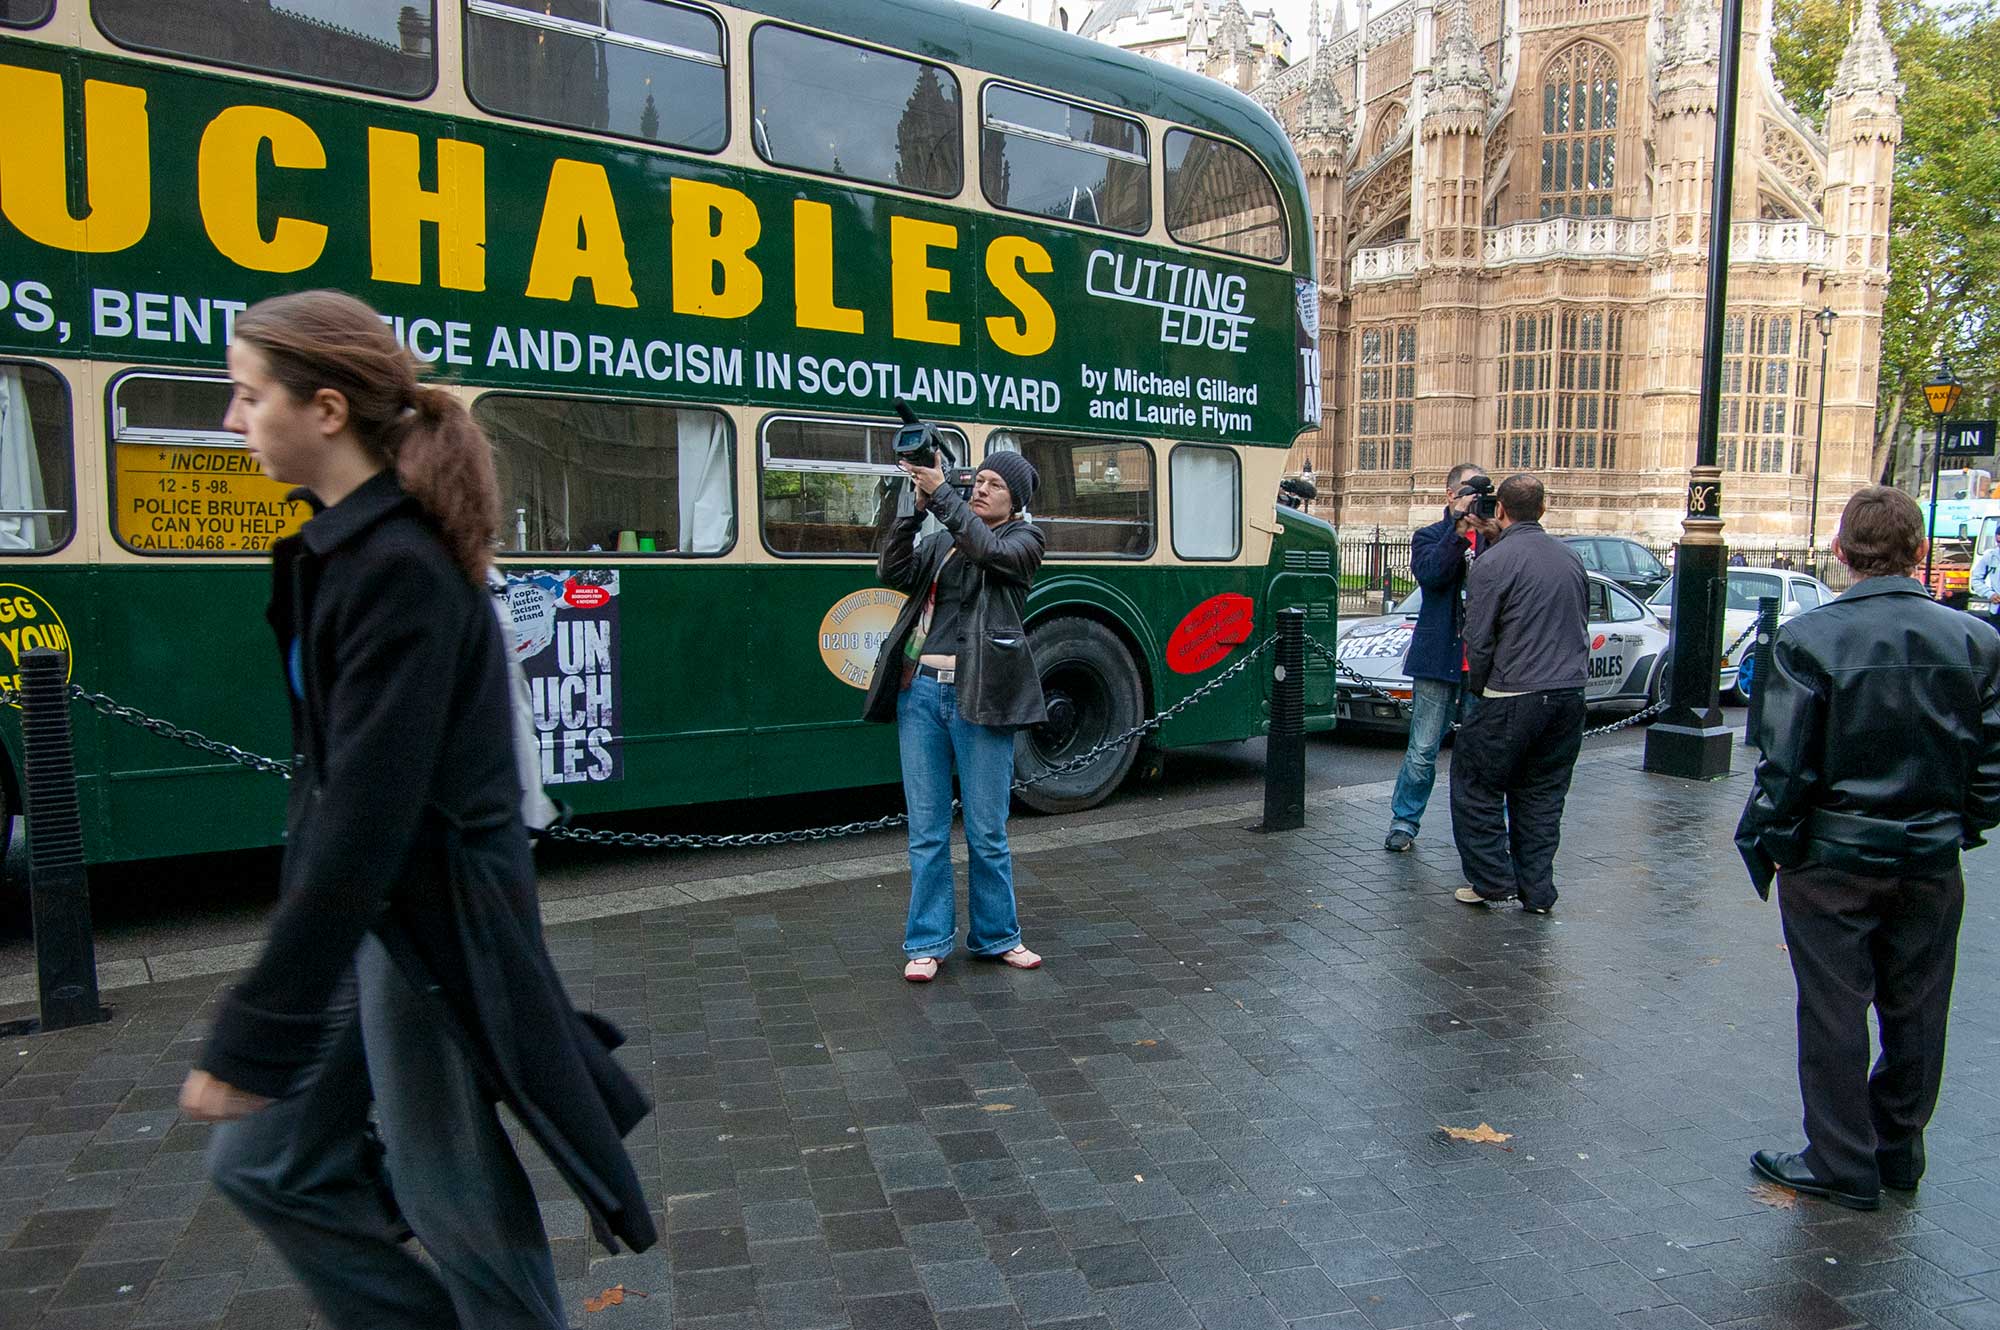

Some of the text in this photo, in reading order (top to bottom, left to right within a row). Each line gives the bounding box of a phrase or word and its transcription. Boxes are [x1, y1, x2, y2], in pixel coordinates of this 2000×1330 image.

[1086, 249, 1249, 318] CUTTING
[1160, 308, 1253, 353] EDGE
[486, 326, 582, 373] AND
[589, 335, 743, 387] RACISM
[756, 351, 791, 390] IN
[797, 356, 977, 405] SCOTLAND
[981, 373, 1061, 414] YARD
[1081, 363, 1258, 406] by Michael Gillard
[1927, 392, 1949, 400] TAXI
[1089, 397, 1252, 435] and Laurie Flynn
[1960, 430, 1981, 447] IN
[158, 478, 176, 493] 12
[191, 480, 201, 493] 5
[133, 498, 299, 517] POLICE BRUTALTY
[151, 517, 286, 534] CAN YOU HELP
[241, 536, 268, 550] 267
[512, 595, 544, 609] justice
[514, 589, 539, 600] cops,
[556, 620, 612, 675] UN
[822, 633, 859, 650] 0208
